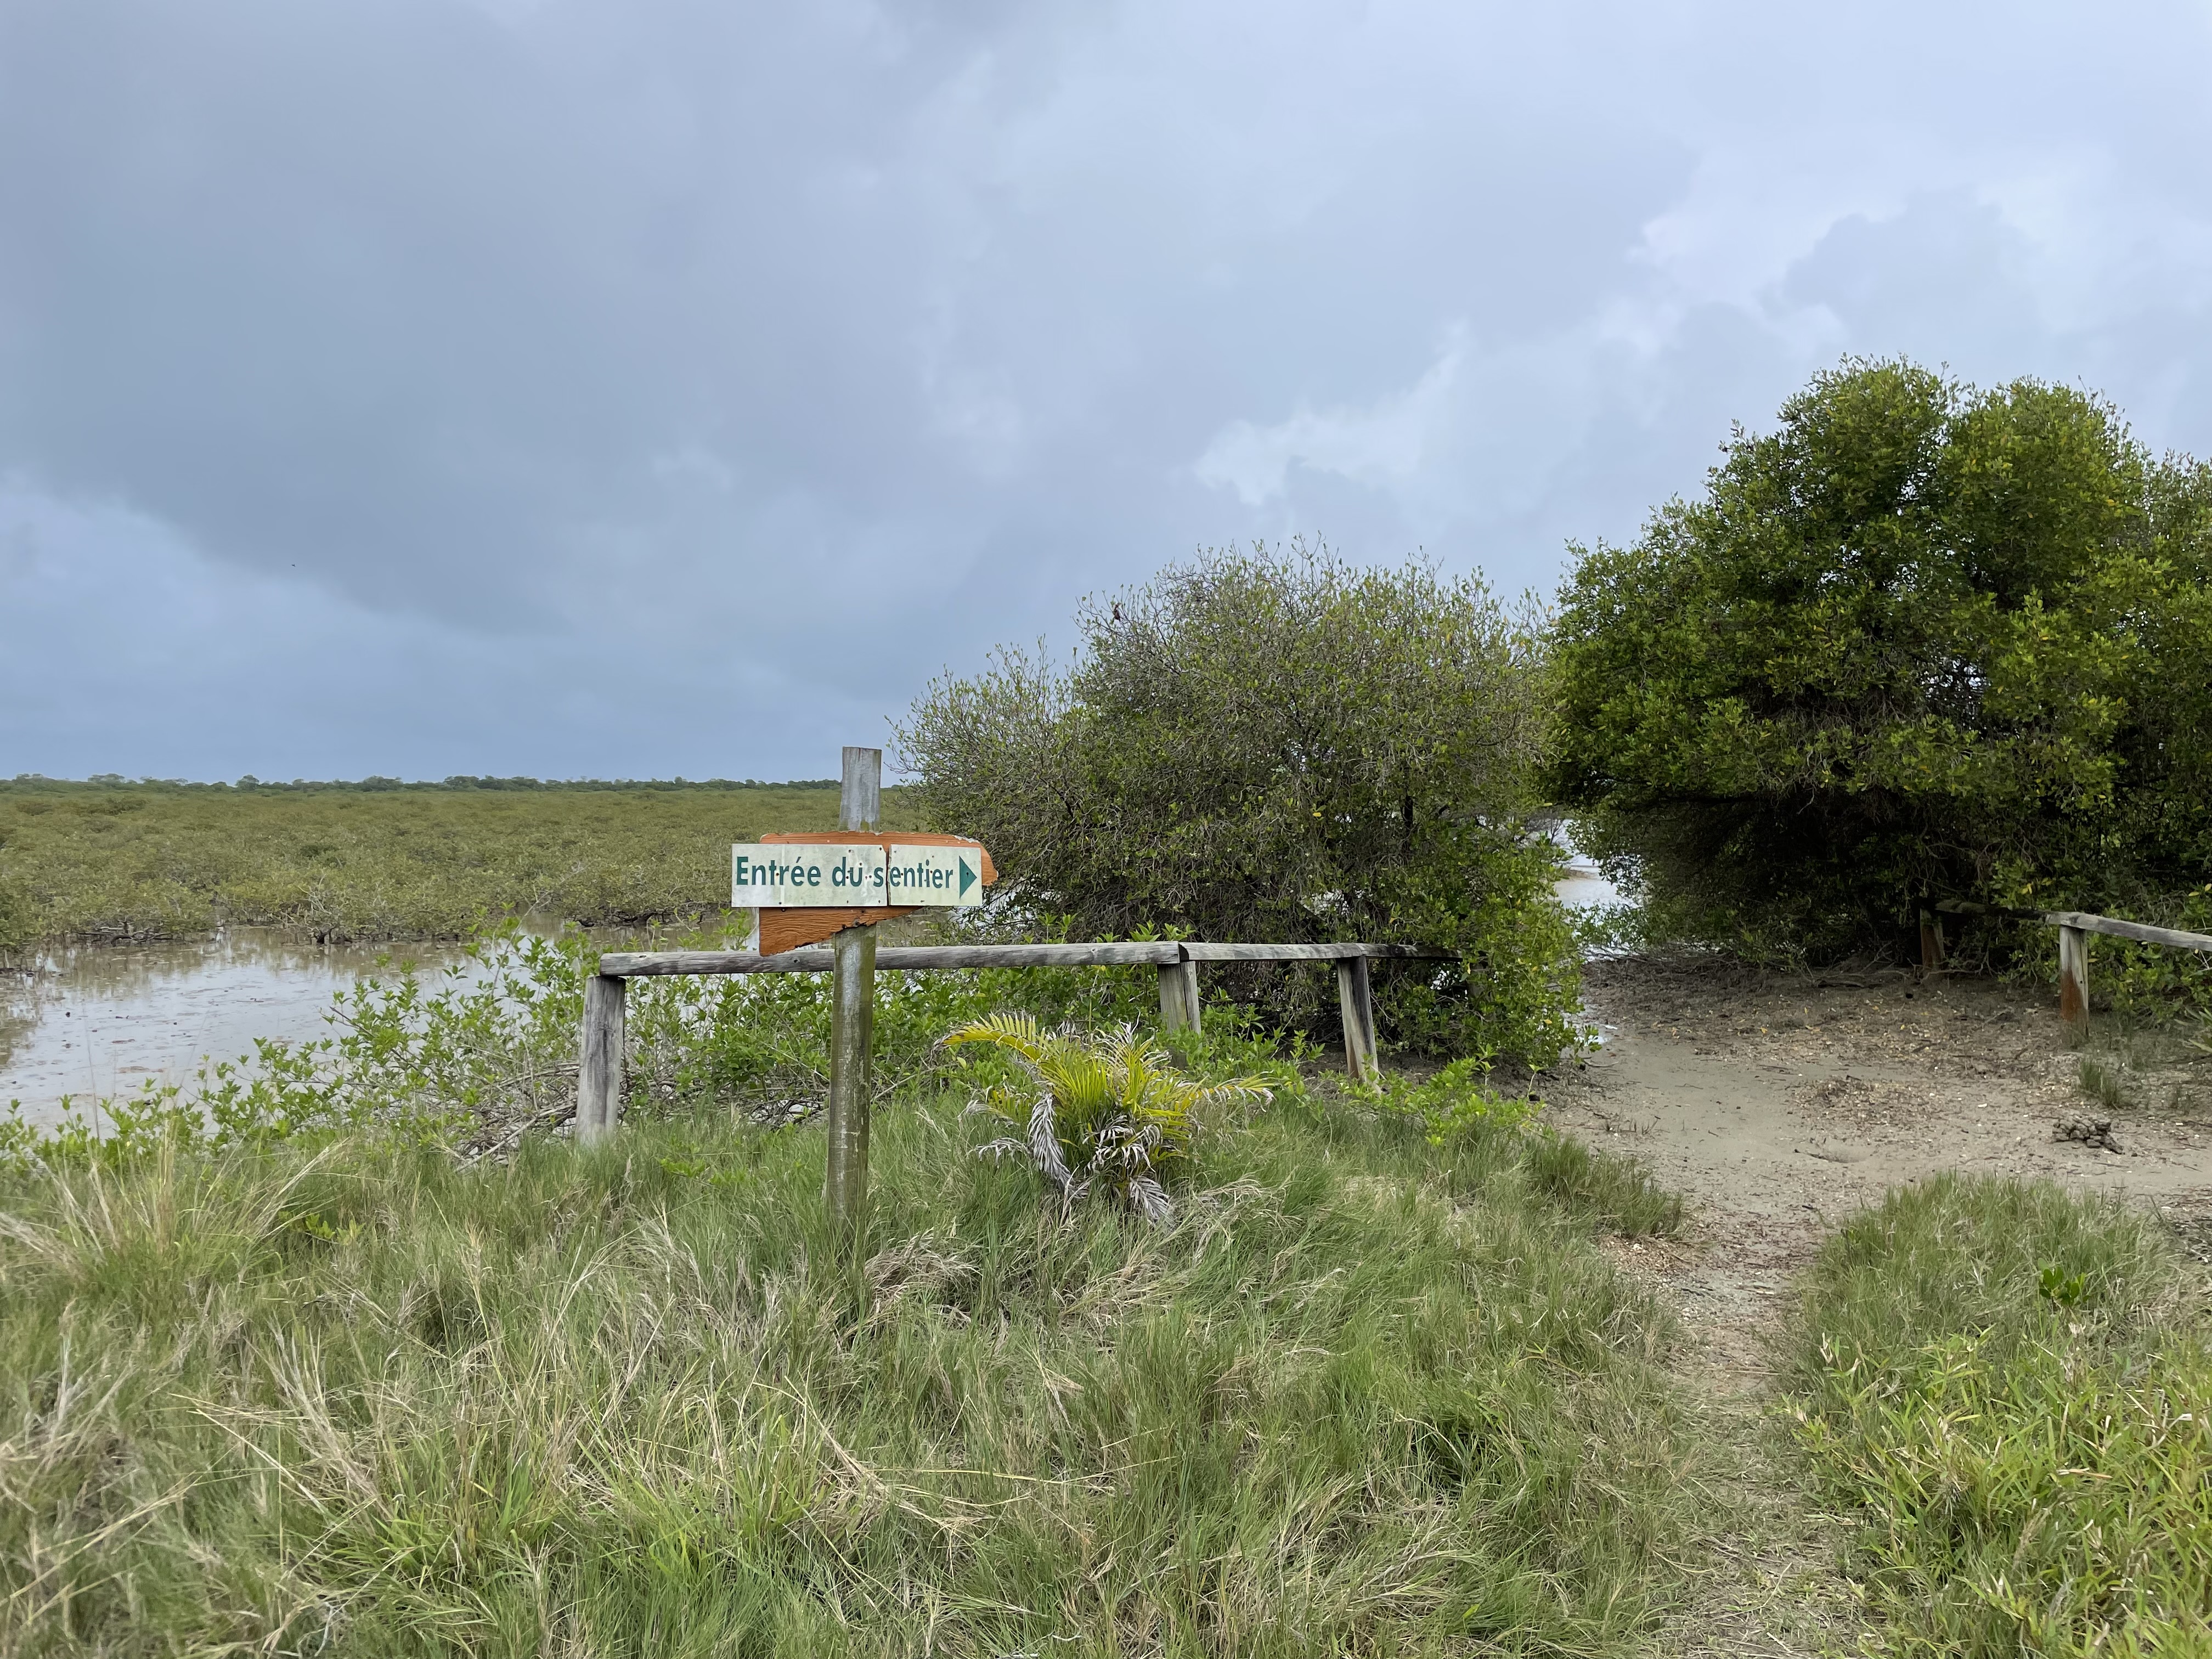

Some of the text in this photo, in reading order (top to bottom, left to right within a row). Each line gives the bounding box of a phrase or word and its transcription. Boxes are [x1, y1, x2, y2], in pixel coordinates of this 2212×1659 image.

[736, 856, 953, 889] Entrée du sentier
